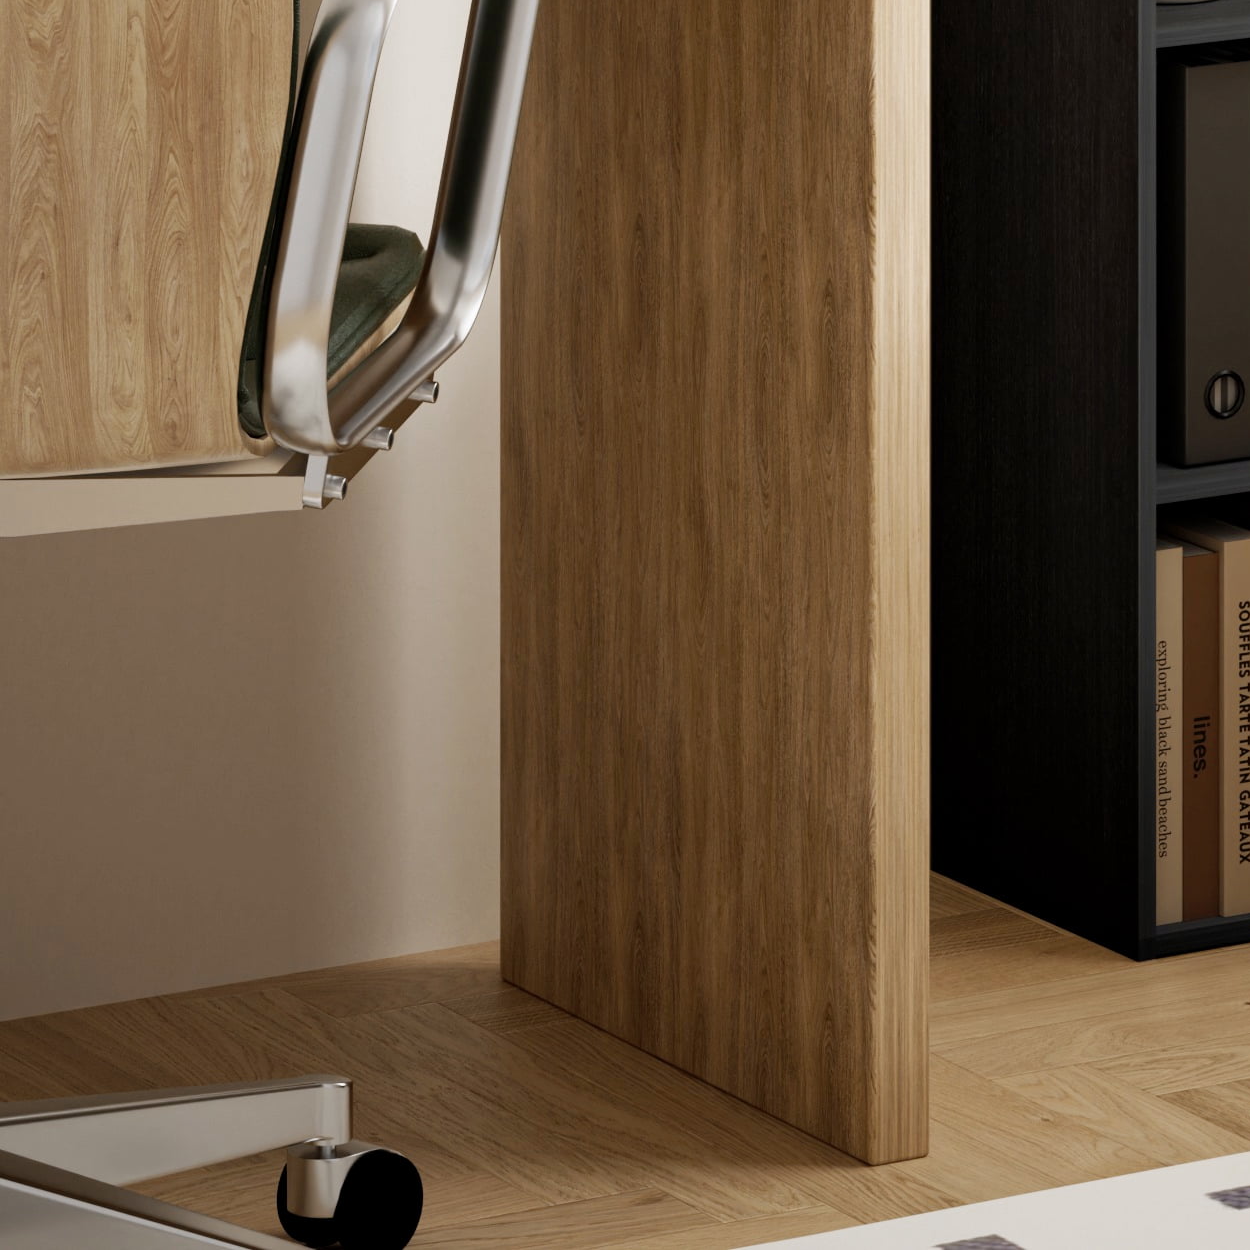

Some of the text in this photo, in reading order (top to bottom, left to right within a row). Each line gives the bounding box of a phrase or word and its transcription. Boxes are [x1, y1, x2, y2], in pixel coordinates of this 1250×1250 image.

[1239, 683, 1250, 732] TARTE
[1156, 640, 1171, 858] exploring black sand beaches
[1193, 715, 1210, 778] lines.
[1239, 736, 1250, 783] TATIN
